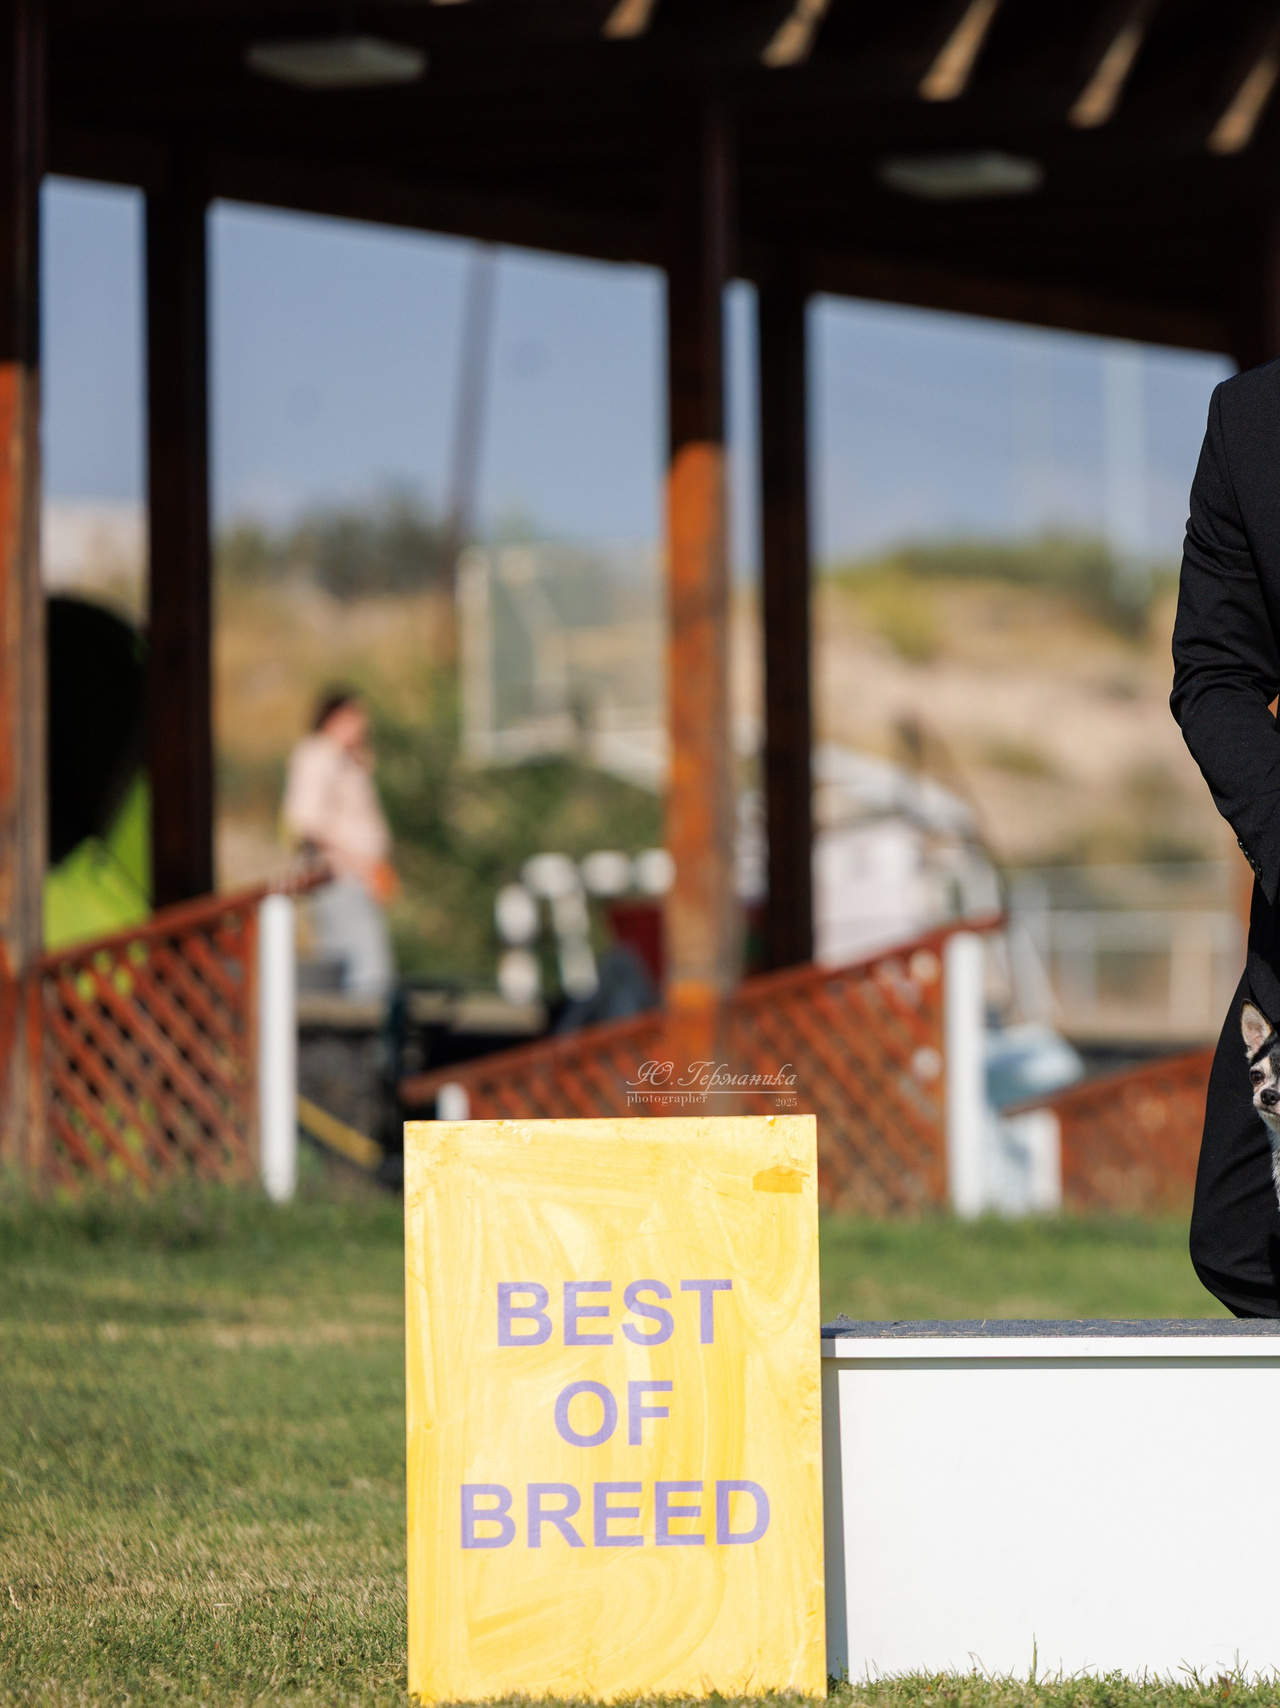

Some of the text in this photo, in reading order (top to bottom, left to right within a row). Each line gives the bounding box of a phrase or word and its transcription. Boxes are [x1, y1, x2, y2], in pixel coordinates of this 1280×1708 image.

[497, 1279, 732, 1346] BEST
[554, 1380, 673, 1447] OF
[460, 1480, 770, 1549] BREED
